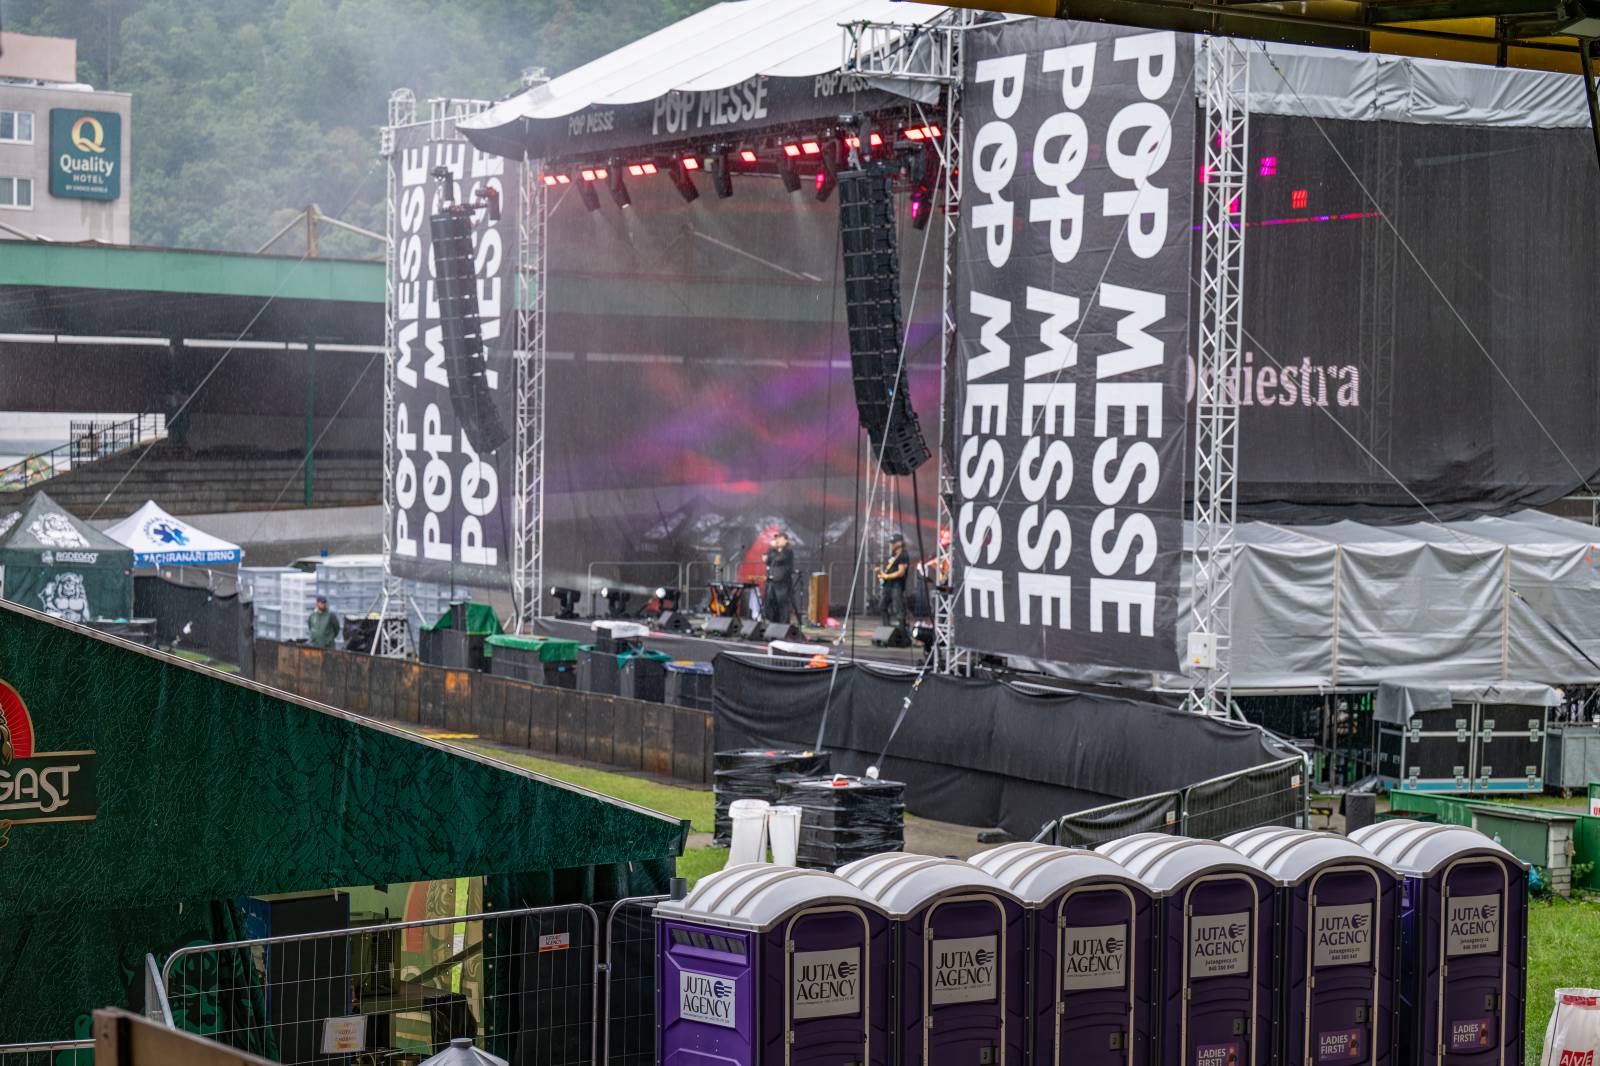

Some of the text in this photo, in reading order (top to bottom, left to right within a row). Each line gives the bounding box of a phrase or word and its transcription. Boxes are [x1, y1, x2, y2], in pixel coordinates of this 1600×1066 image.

[814, 72, 839, 97] POP
[652, 75, 768, 135] POP MESSE
[568, 110, 615, 136] POP MESSE
[60, 154, 114, 177] Quality
[73, 174, 104, 184] HOTEL
[959, 53, 1027, 622] POP MESSE
[1018, 42, 1097, 630] POP MESSE
[1090, 30, 1176, 637] POP MESSE
[395, 145, 429, 557] POP MESSE
[423, 402, 452, 562] POP
[460, 427, 498, 566] PO
[207, 550, 235, 561] BRNO
[1318, 916, 1350, 931] JUTA
[1451, 907, 1480, 921] JUTA
[1195, 926, 1228, 942] JUTA
[1451, 919, 1498, 936] AGENCY
[1318, 929, 1369, 946] AGENCY
[1067, 938, 1104, 957] JUTA
[1195, 938, 1247, 958] AGENCY
[936, 951, 974, 969] JUTA
[1066, 954, 1123, 973] AGENCY
[797, 963, 837, 982] JUTA
[935, 966, 993, 987] AGENCY
[683, 975, 713, 997] JUTA
[796, 978, 857, 1001] AGENCY
[683, 993, 731, 1019] AGENCY
[1453, 1023, 1479, 1034] LADIES
[1453, 1033, 1476, 1043] FIRST!
[1320, 1034, 1348, 1045] LADIES
[1198, 1049, 1226, 1058] LADIES
[1320, 1044, 1345, 1055] FIRST!
